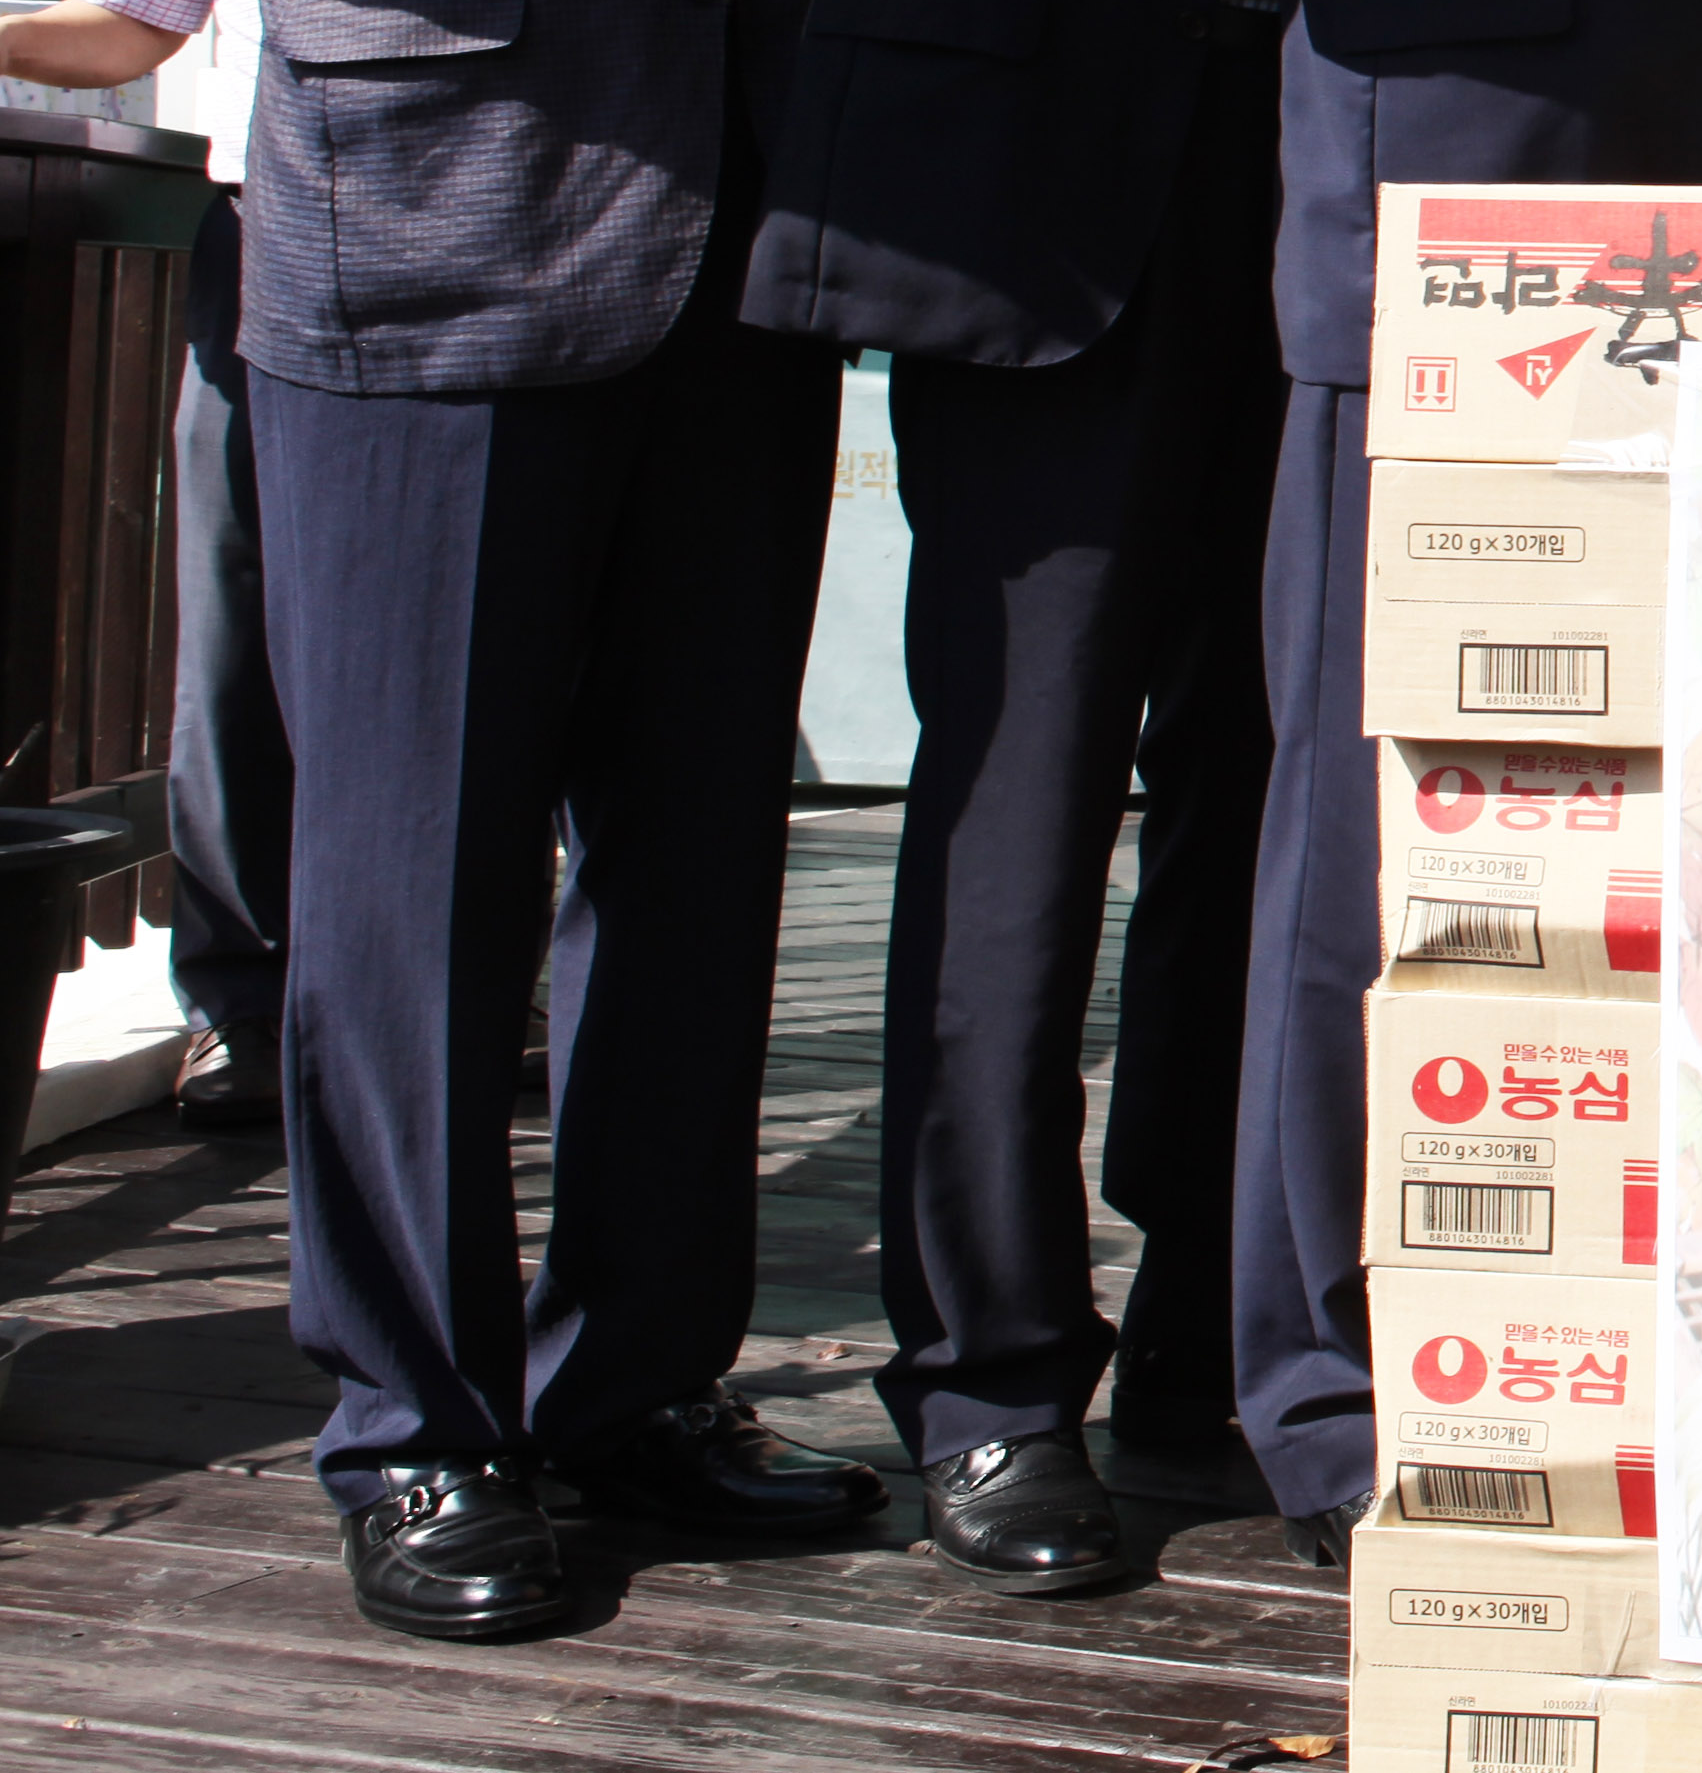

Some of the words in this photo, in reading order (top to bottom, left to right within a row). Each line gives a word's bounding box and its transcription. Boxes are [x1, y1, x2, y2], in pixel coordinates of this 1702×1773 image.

[1425, 533, 1463, 551] 120
[1551, 630, 1609, 642] 101002281
[1485, 695, 1582, 707] 8801043014816
[1495, 775, 1625, 832] 농심
[1420, 855, 1446, 872] 120
[1485, 888, 1541, 901] 101002281
[1498, 1065, 1629, 1122] 농심
[1418, 1140, 1450, 1156] 120
[1496, 1170, 1554, 1182] 101002281
[1429, 1232, 1525, 1246] 8801043014816
[1497, 1345, 1628, 1406] 농심
[1414, 1420, 1446, 1437] 120
[1488, 1453, 1546, 1467] 101002281
[1408, 1598, 1446, 1617] 120
